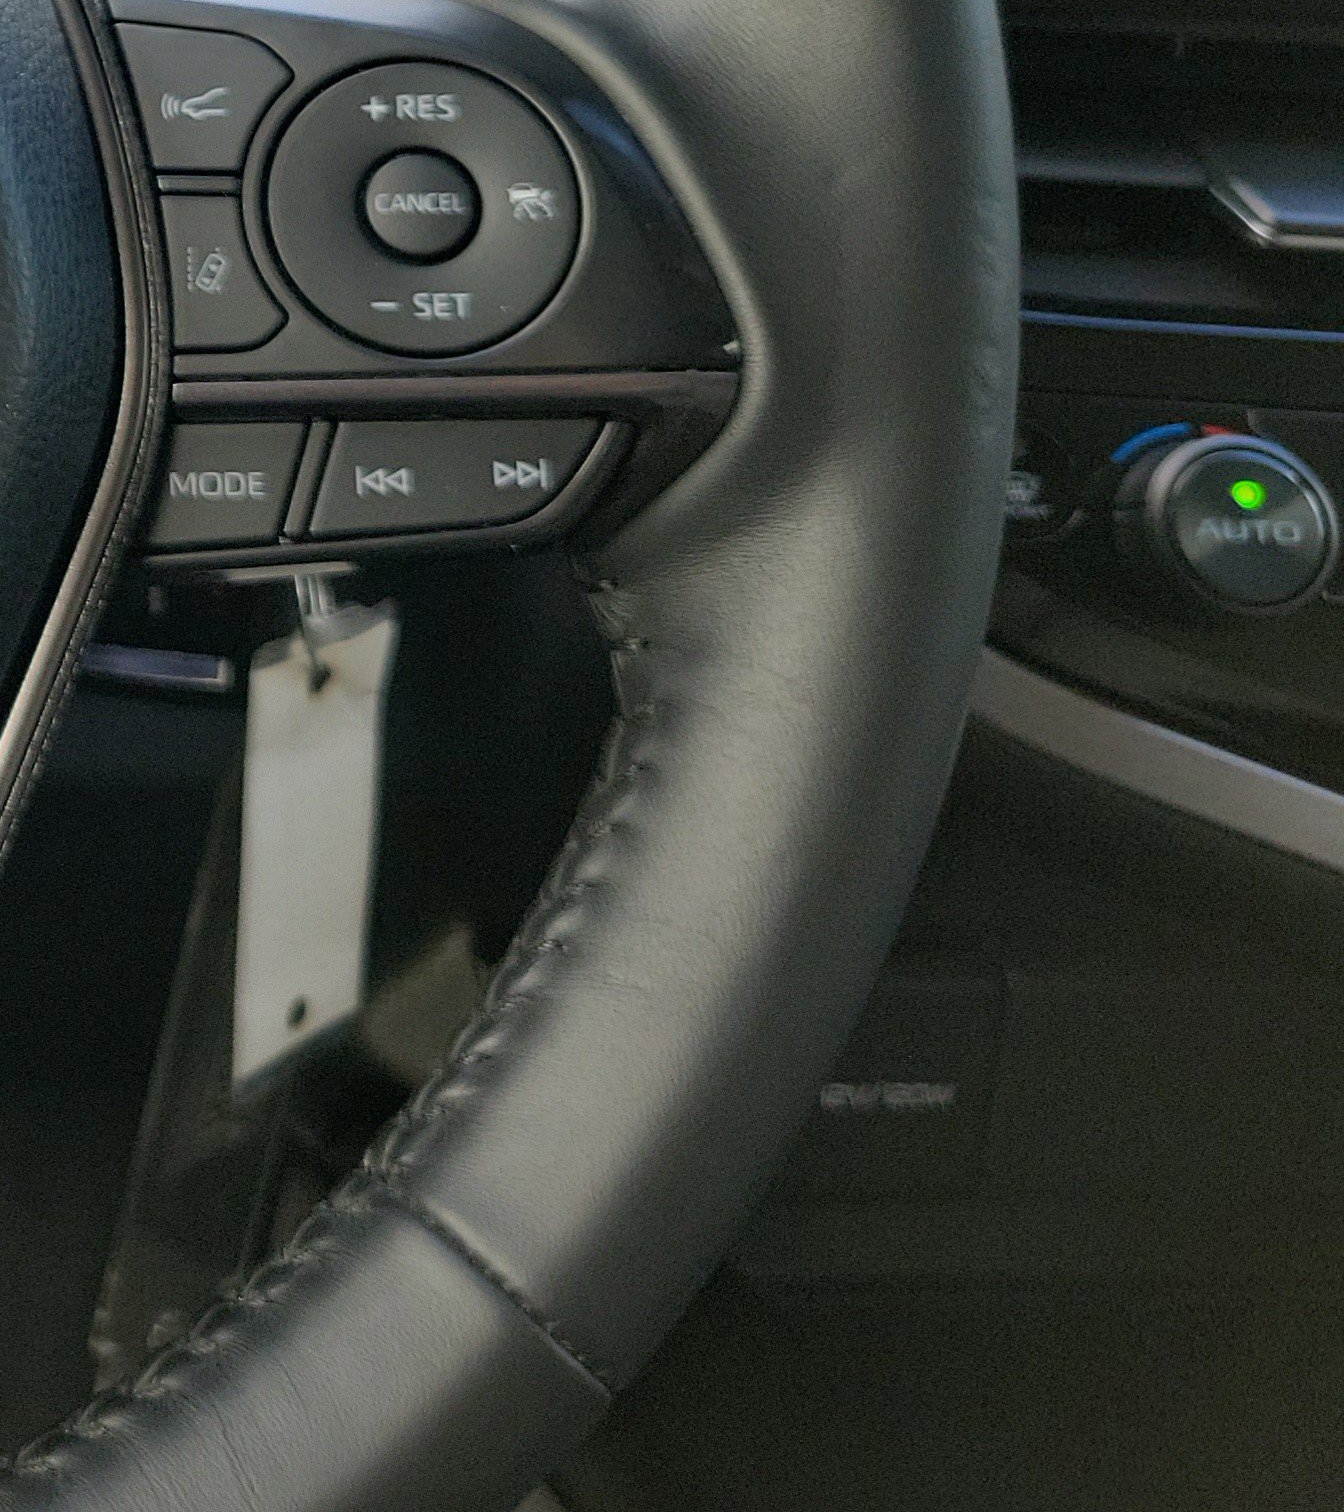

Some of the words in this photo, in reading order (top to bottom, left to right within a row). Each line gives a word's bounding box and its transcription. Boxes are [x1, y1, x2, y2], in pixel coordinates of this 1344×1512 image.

[373, 192, 465, 215] CANCEL
[413, 293, 472, 319] SET
[168, 469, 267, 500] MODE
[1196, 517, 1302, 545] AUTO
